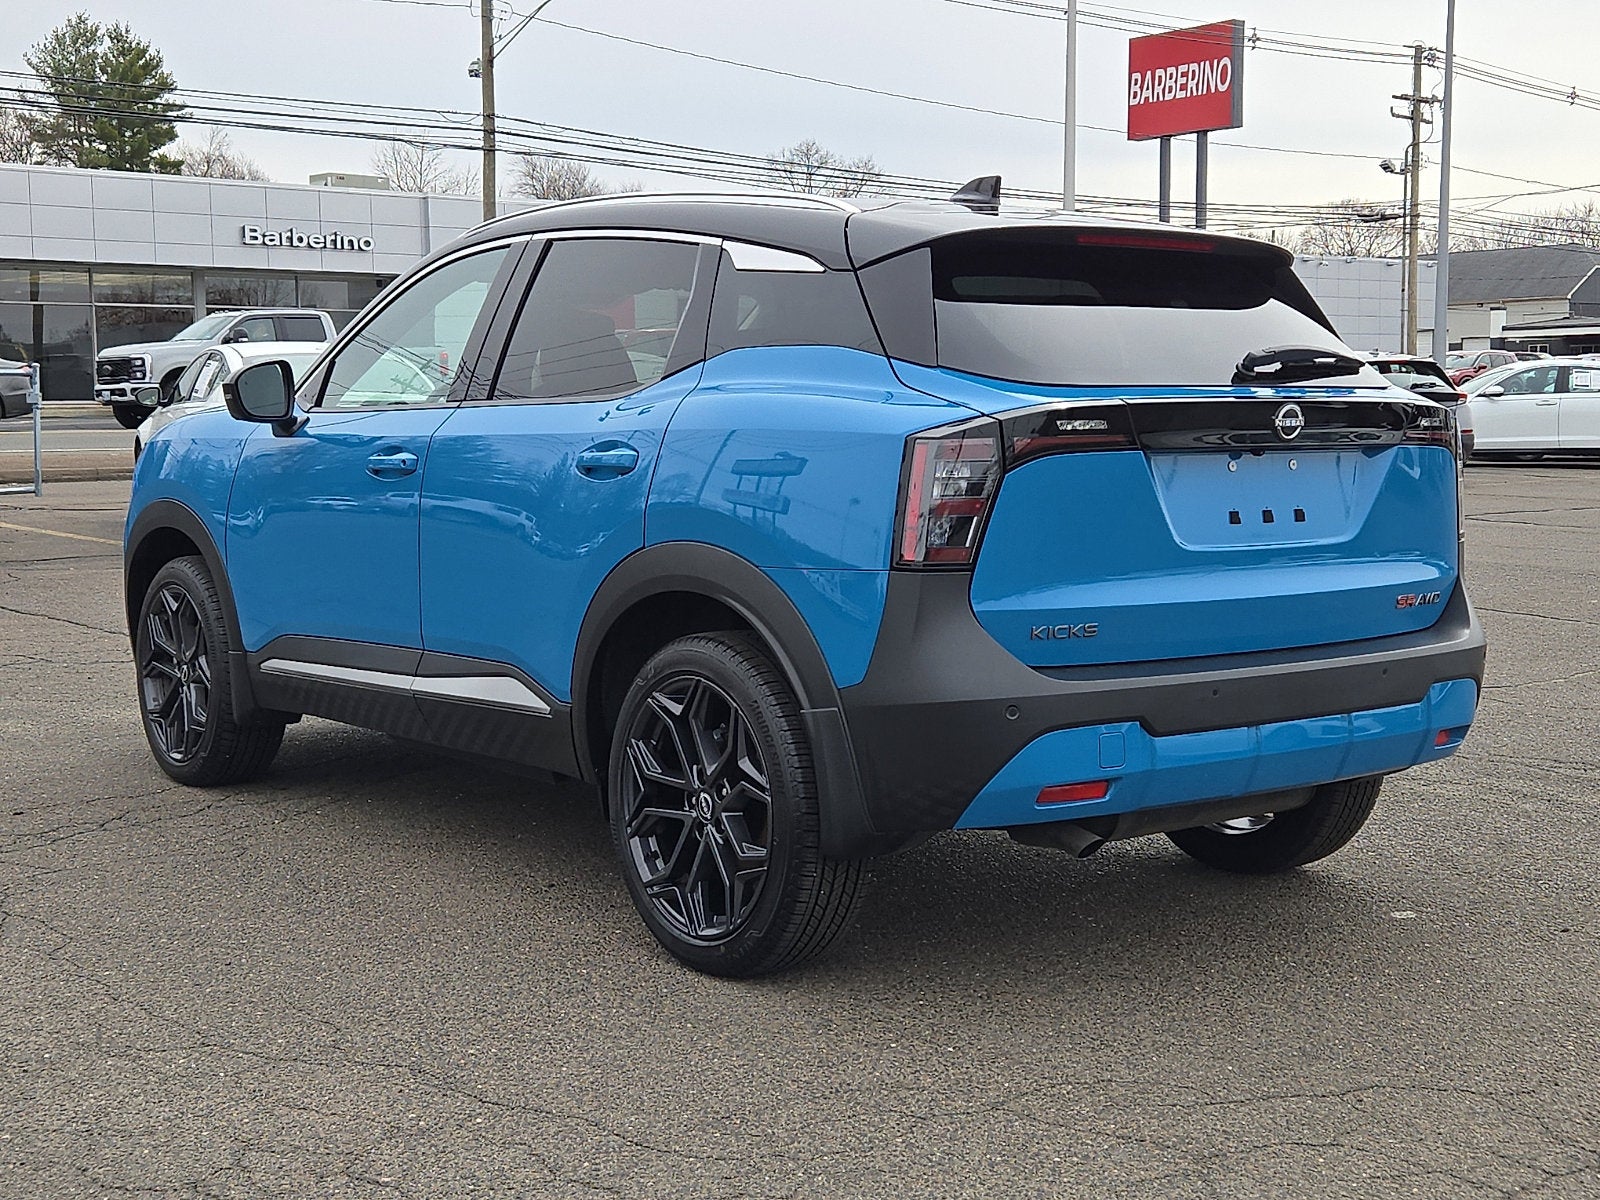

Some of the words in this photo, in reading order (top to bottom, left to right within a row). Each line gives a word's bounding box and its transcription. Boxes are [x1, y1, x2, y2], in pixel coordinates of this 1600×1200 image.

[1129, 56, 1232, 105] BARBERINO
[242, 224, 375, 251] Barberino
[1030, 622, 1099, 640] KICKS
